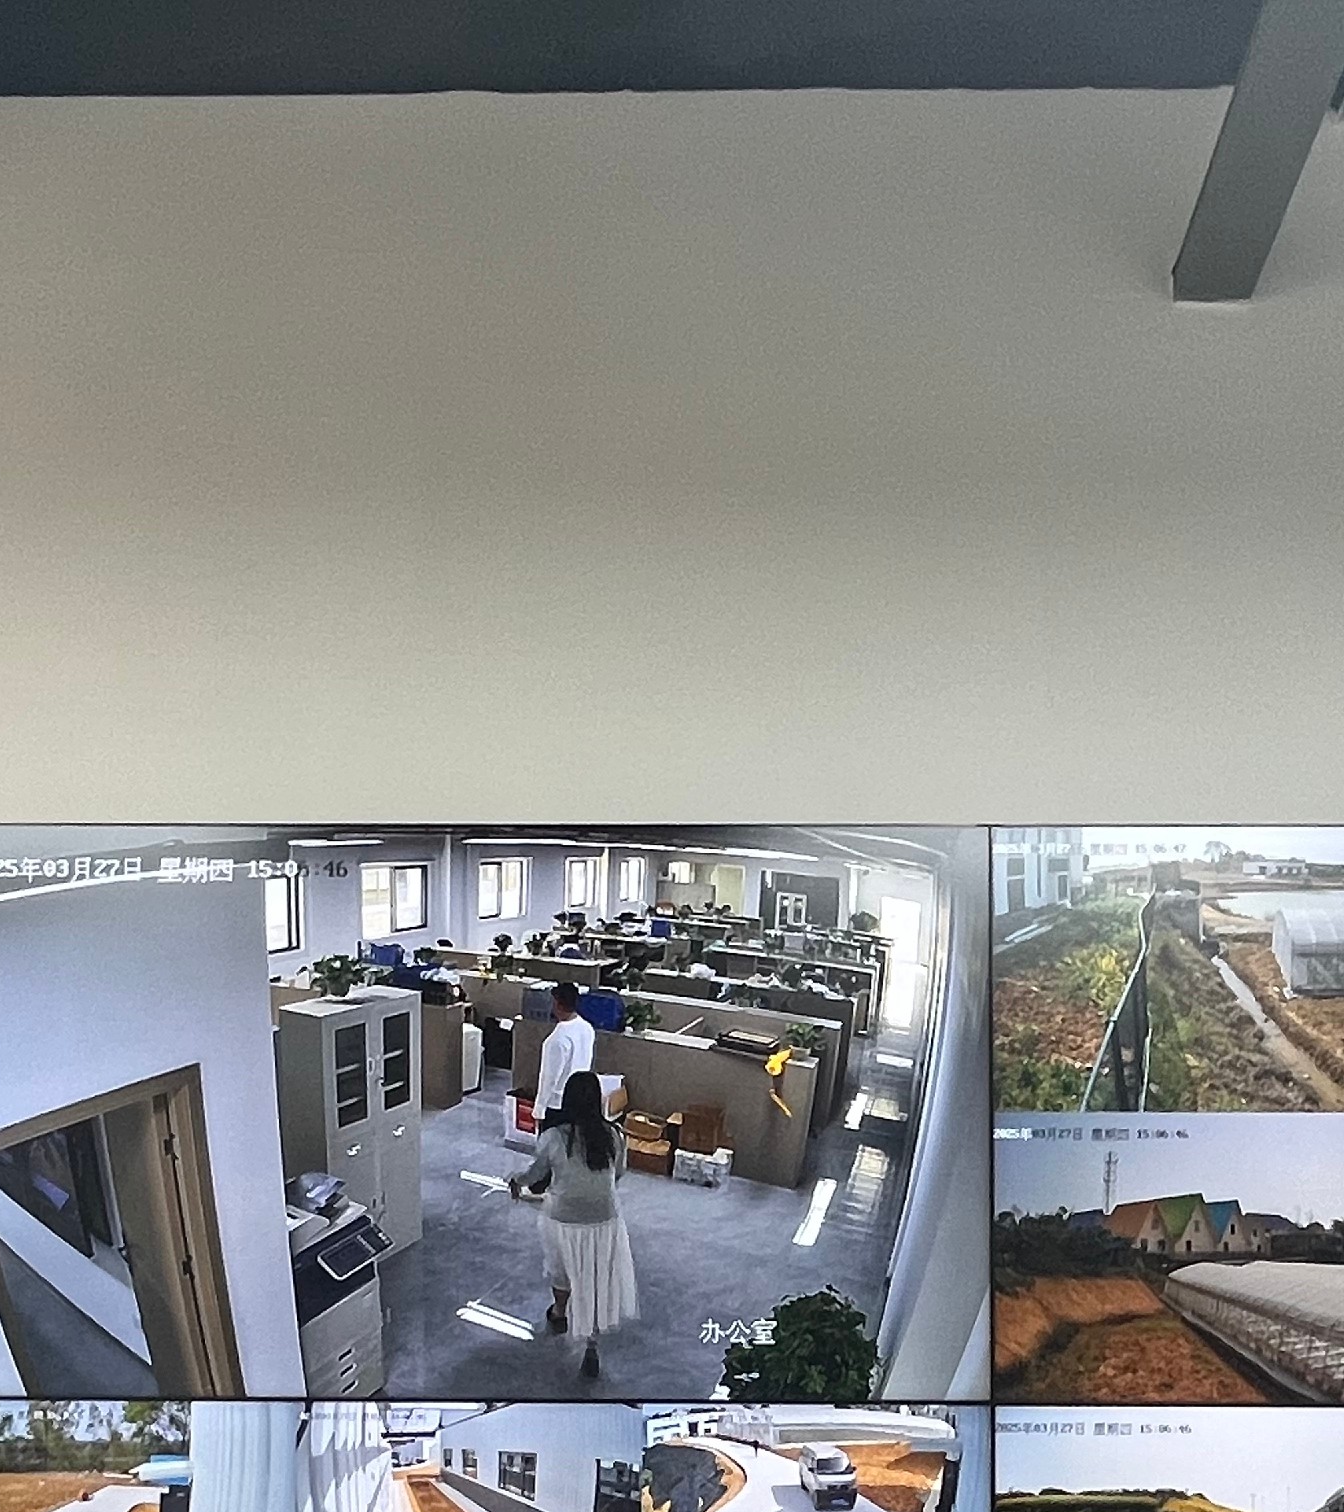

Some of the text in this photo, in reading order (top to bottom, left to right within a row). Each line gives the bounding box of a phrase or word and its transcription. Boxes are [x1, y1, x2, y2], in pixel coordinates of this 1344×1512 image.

[157, 856, 234, 884] 星期四
[699, 1318, 778, 1348] 办公室
